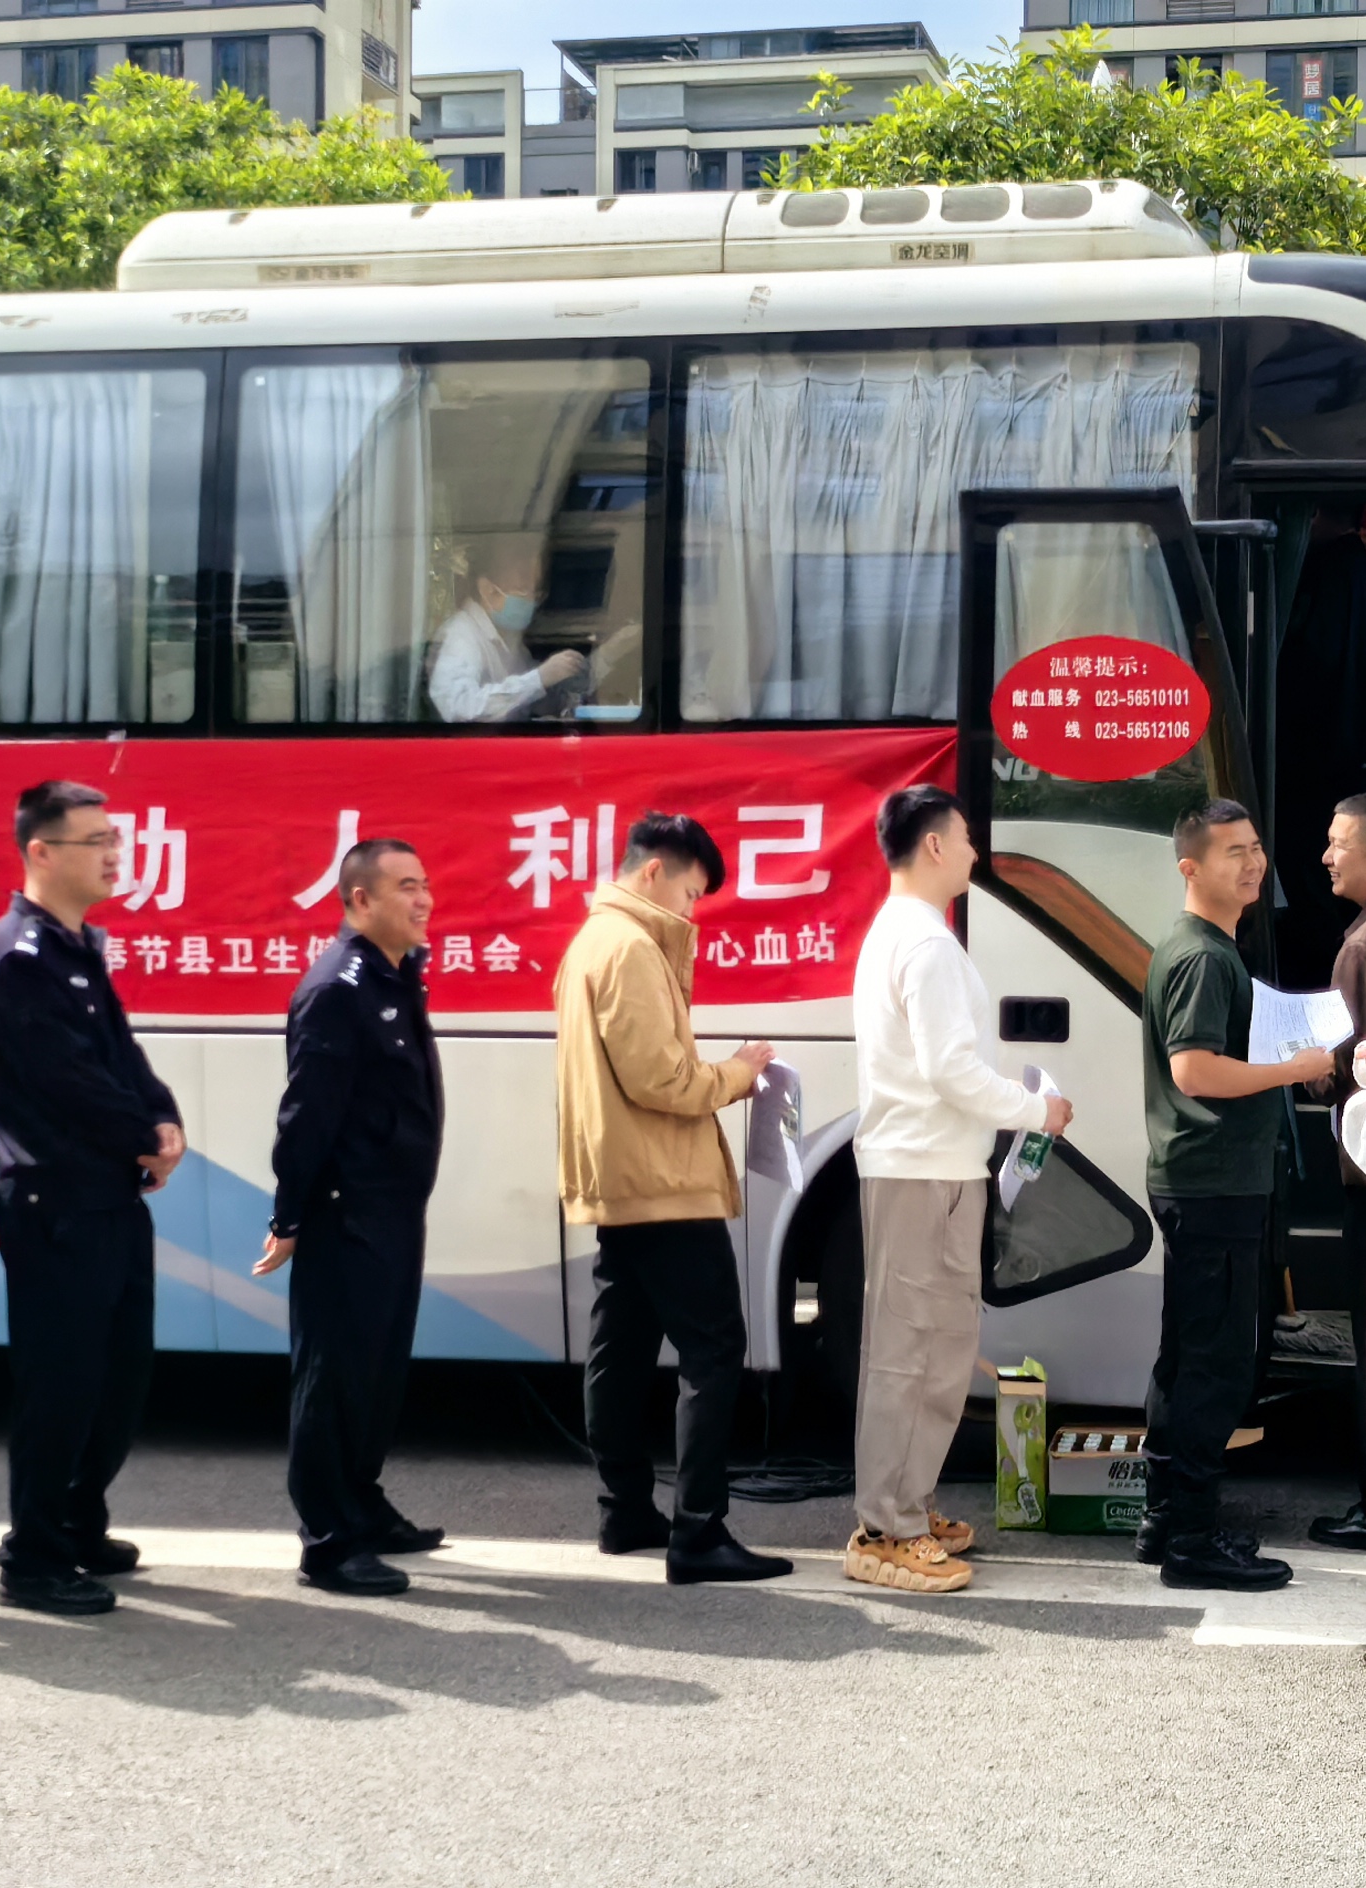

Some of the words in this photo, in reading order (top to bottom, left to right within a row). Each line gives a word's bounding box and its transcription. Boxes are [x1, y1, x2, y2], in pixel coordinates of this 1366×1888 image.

[898, 242, 969, 260] 金龙空调
[1049, 656, 1148, 678] 温馨提示：
[1012, 688, 1081, 707] 献血服务
[1095, 688, 1190, 706] 023-56510101
[1095, 721, 1190, 739] 023-56512106
